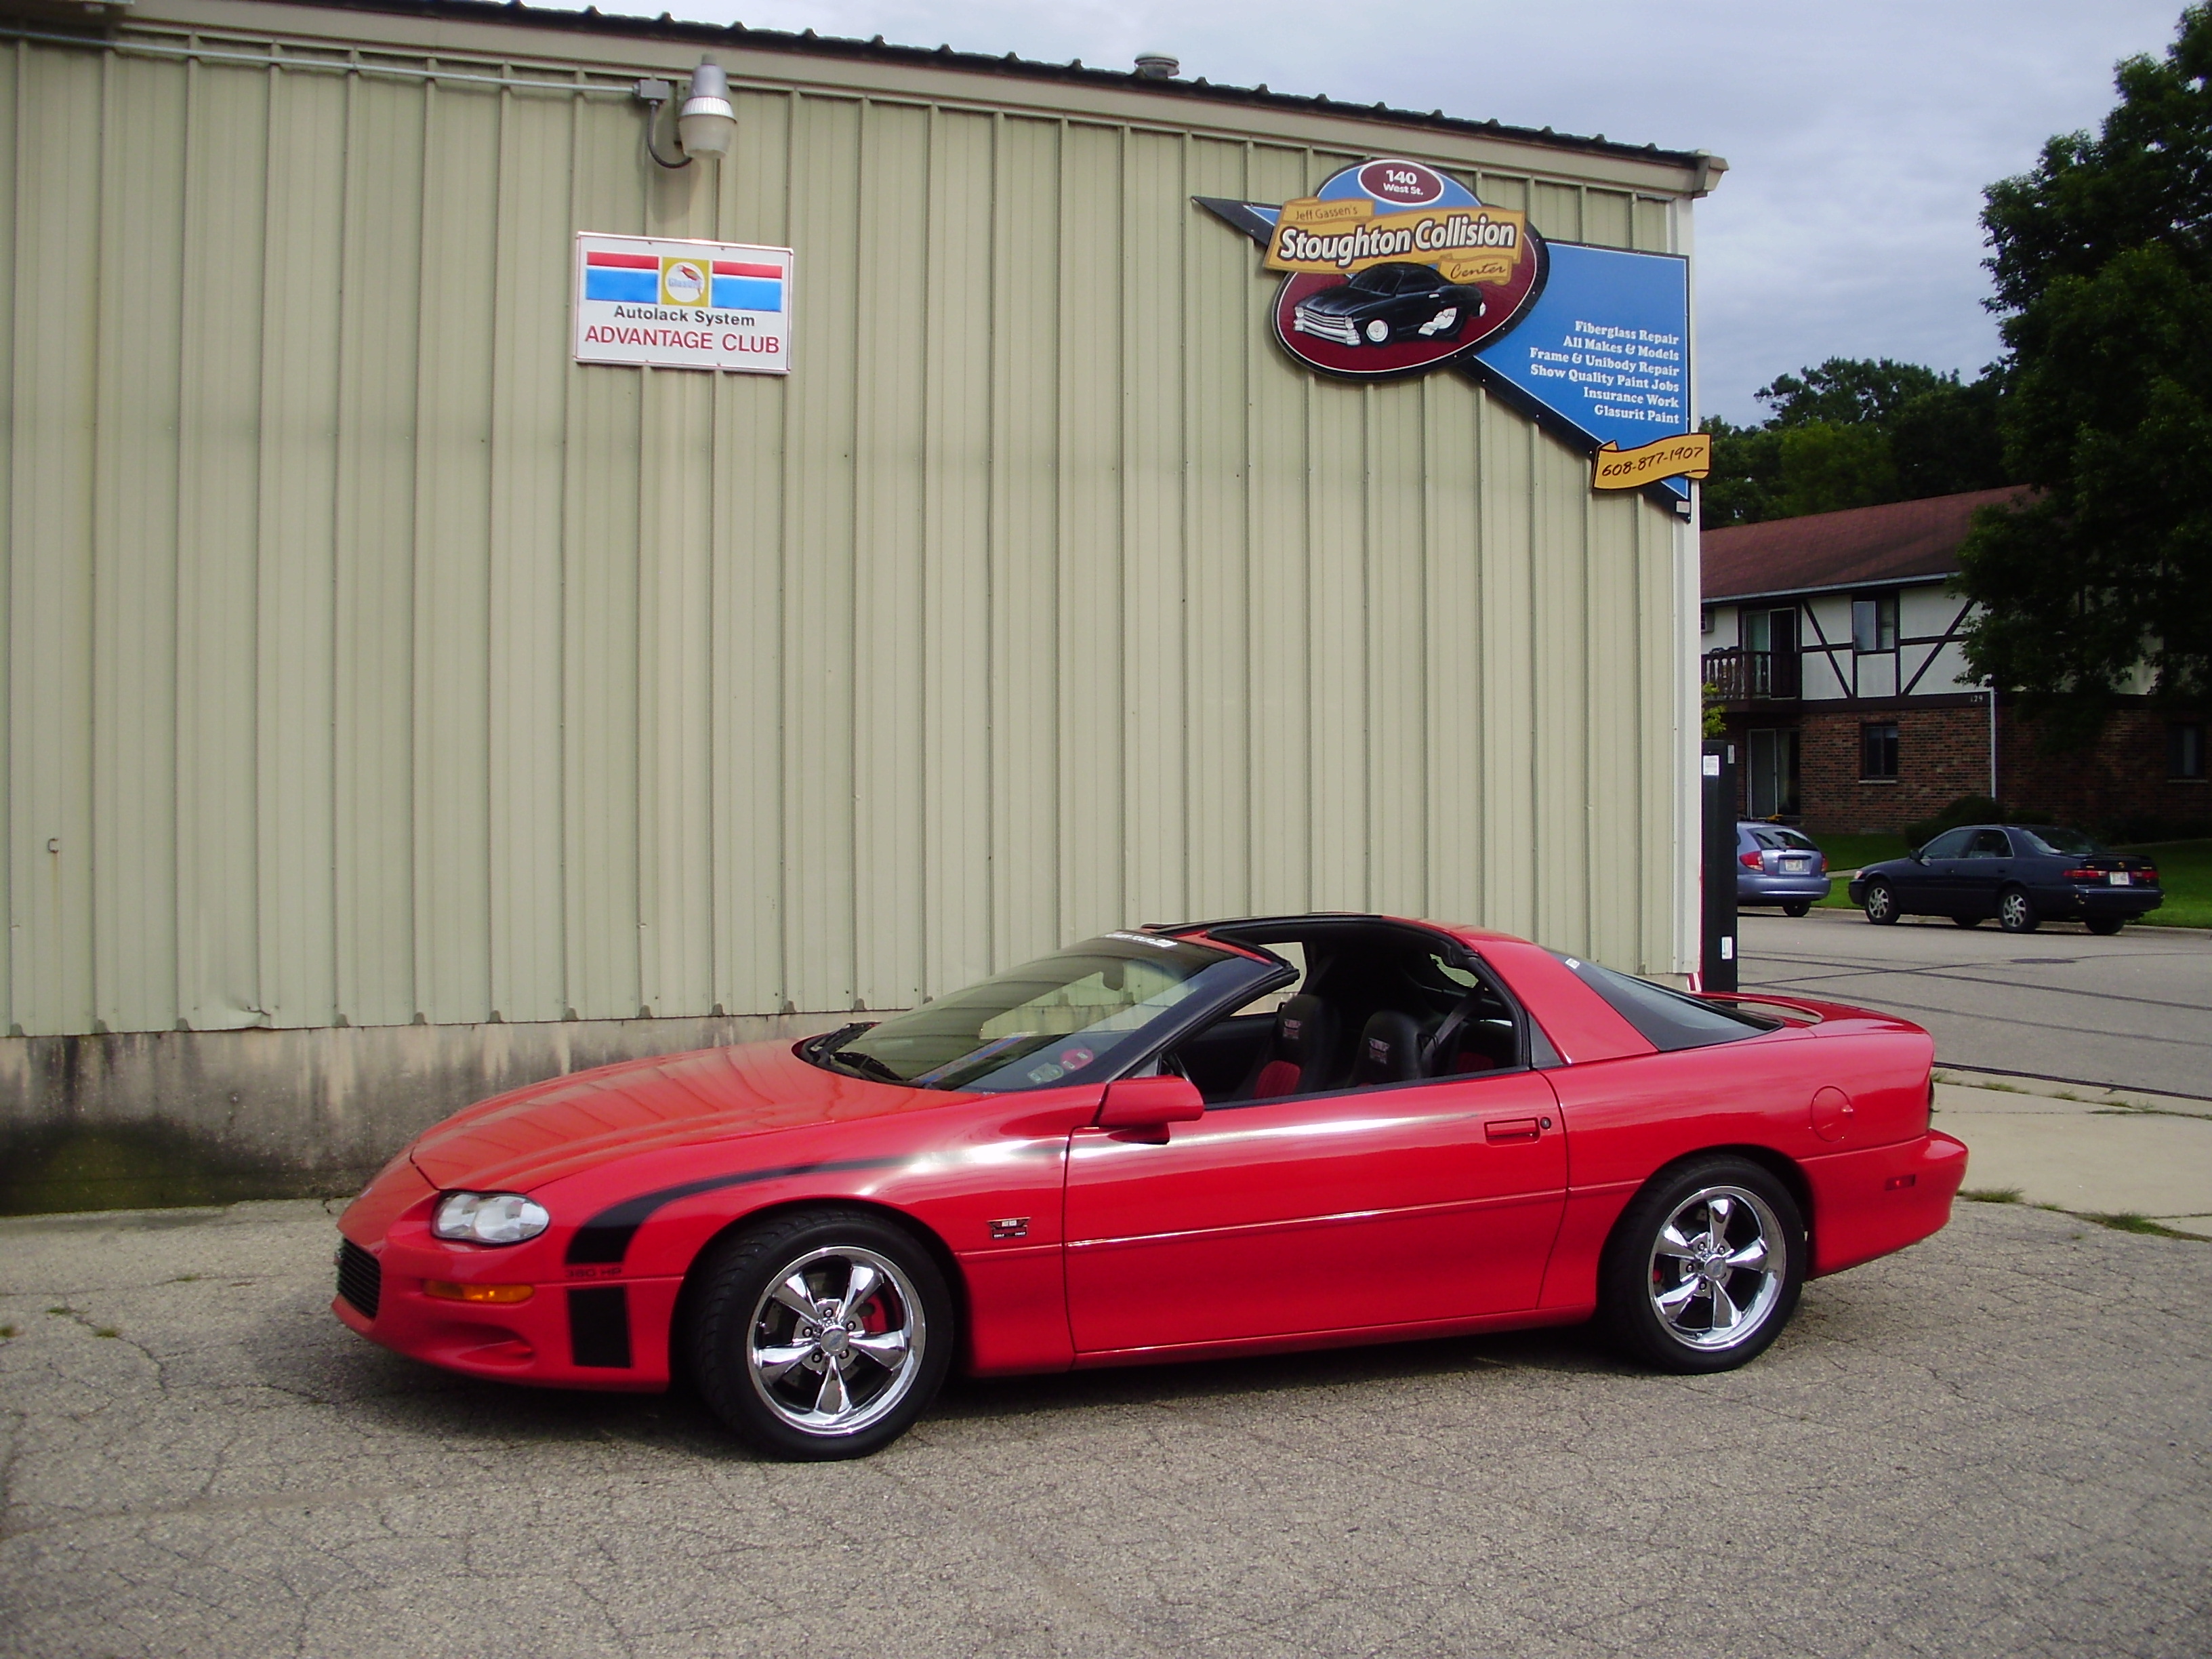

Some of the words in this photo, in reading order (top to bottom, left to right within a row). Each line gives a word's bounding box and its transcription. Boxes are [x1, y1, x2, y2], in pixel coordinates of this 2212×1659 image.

[1386, 169, 1417, 184] 140
[1383, 182, 1409, 194] West
[1410, 185, 1423, 196] St.
[1295, 209, 1313, 221] Jeff
[1315, 205, 1358, 219] Gassen's
[1279, 225, 1410, 266] Stoughton
[1415, 216, 1515, 249] Collision
[1450, 262, 1506, 279] Center
[613, 305, 689, 323] Autolack
[695, 310, 756, 327] System
[585, 325, 713, 350] ADVANTAGE
[722, 333, 780, 354] CLUB
[1575, 320, 1636, 340] Fiberglass
[1639, 329, 1679, 346] Repair
[1563, 335, 1582, 349] All
[1584, 339, 1622, 354] Makes
[1625, 344, 1636, 355] &
[1638, 346, 1679, 361] Models
[1530, 347, 1569, 363] Frame
[1572, 352, 1582, 364] &
[1585, 354, 1637, 373] Unibody
[1639, 361, 1679, 377] Repair
[1530, 363, 1566, 378] Show
[1568, 368, 1614, 386] Quality
[1617, 375, 1649, 389] Paint
[1651, 380, 1679, 392] Jobs
[1583, 386, 1643, 405] Insurance
[1646, 394, 1679, 408] Work
[1594, 404, 1645, 421] Glasurit
[1647, 411, 1679, 424] Paint
[1601, 447, 1704, 477] 608-877-1907
